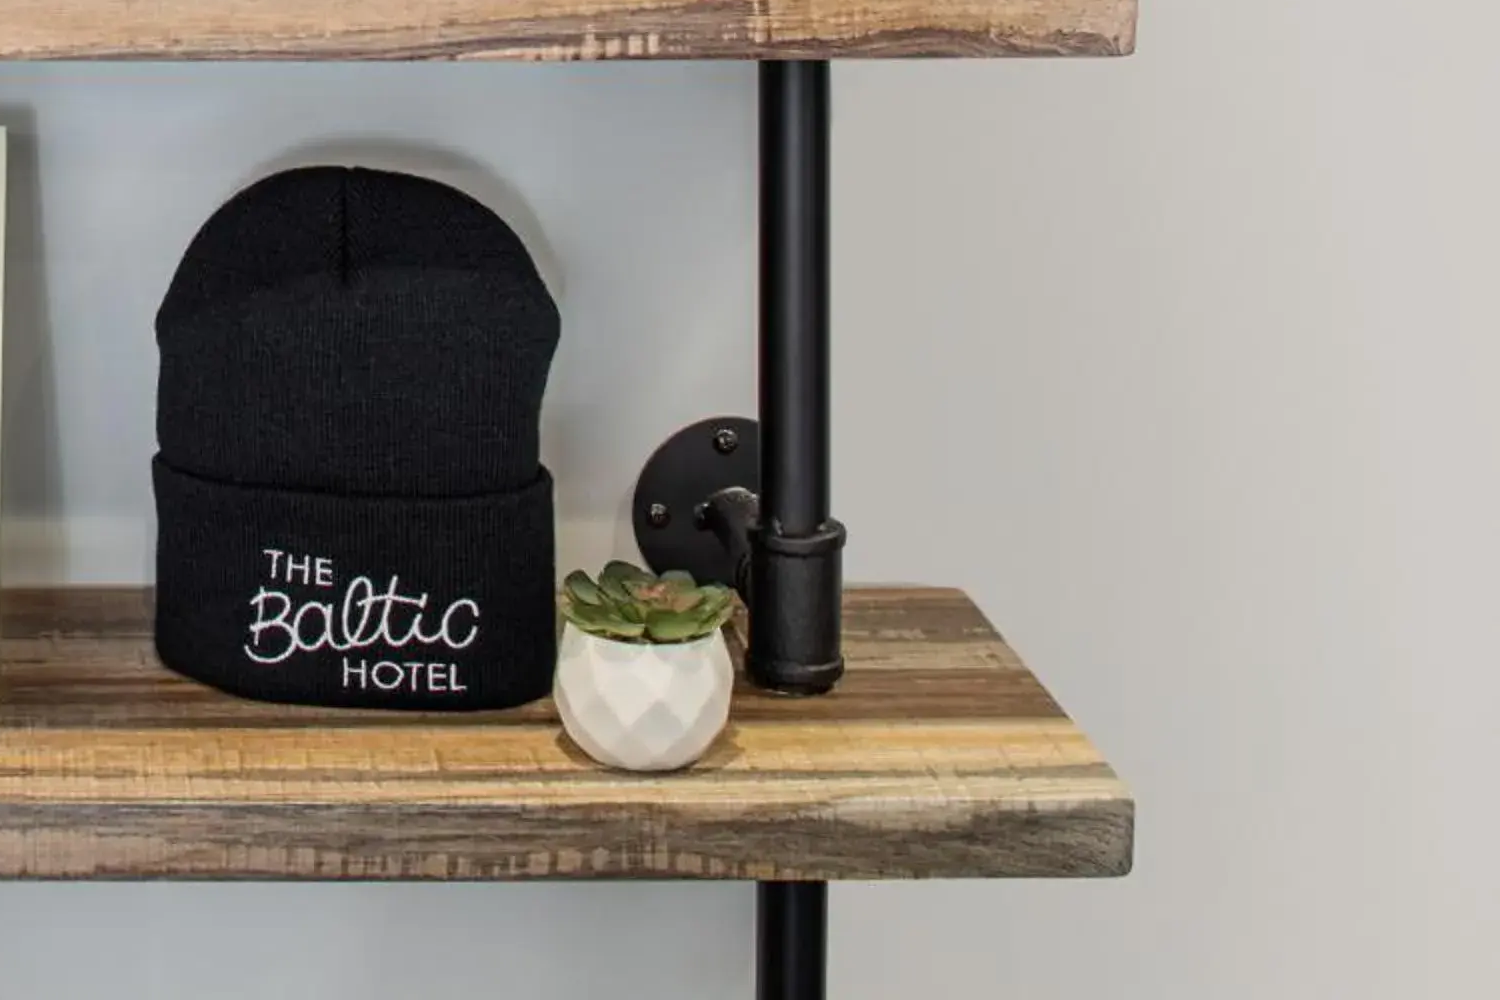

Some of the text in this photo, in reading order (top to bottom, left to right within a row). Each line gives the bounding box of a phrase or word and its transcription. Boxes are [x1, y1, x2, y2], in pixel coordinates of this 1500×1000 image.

[264, 549, 333, 587] THE
[244, 575, 479, 664] Baltic
[343, 657, 467, 692] HOTEL
